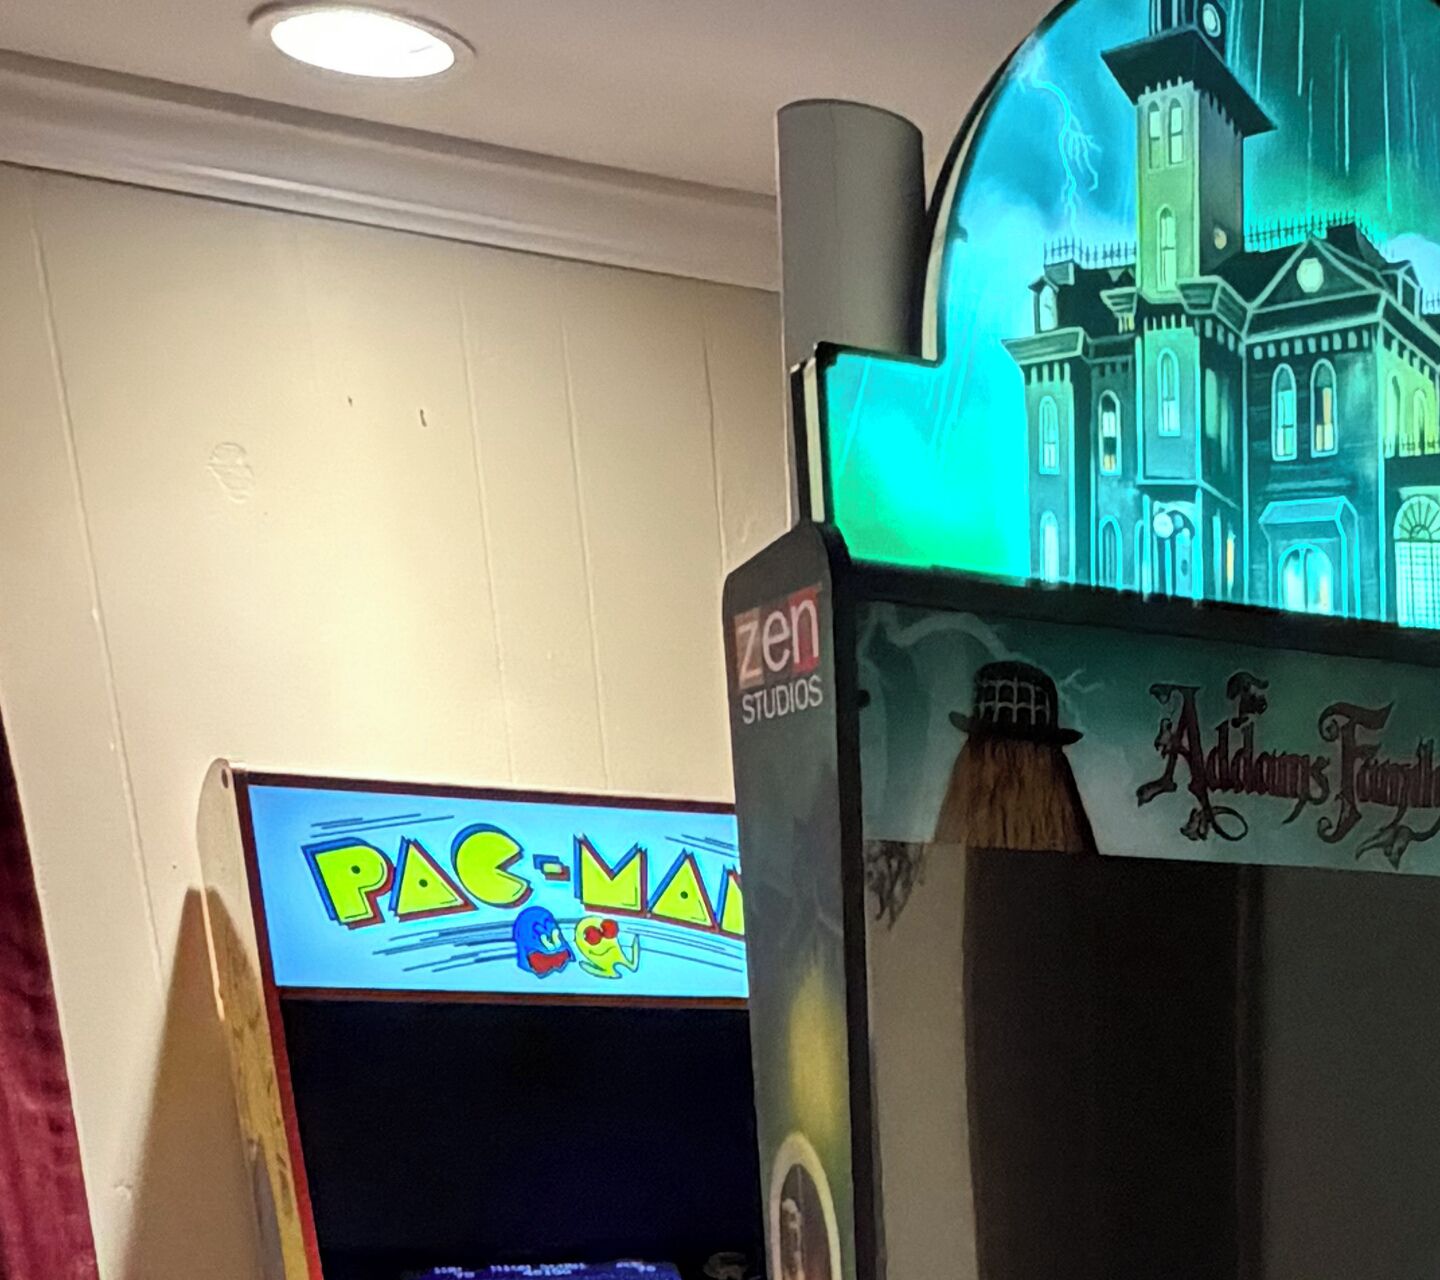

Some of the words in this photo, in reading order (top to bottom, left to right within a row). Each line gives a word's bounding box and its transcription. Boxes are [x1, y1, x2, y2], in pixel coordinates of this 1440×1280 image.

[737, 598, 820, 682] zen
[742, 674, 824, 725] STUDIOS
[1136, 682, 1332, 842] Addams
